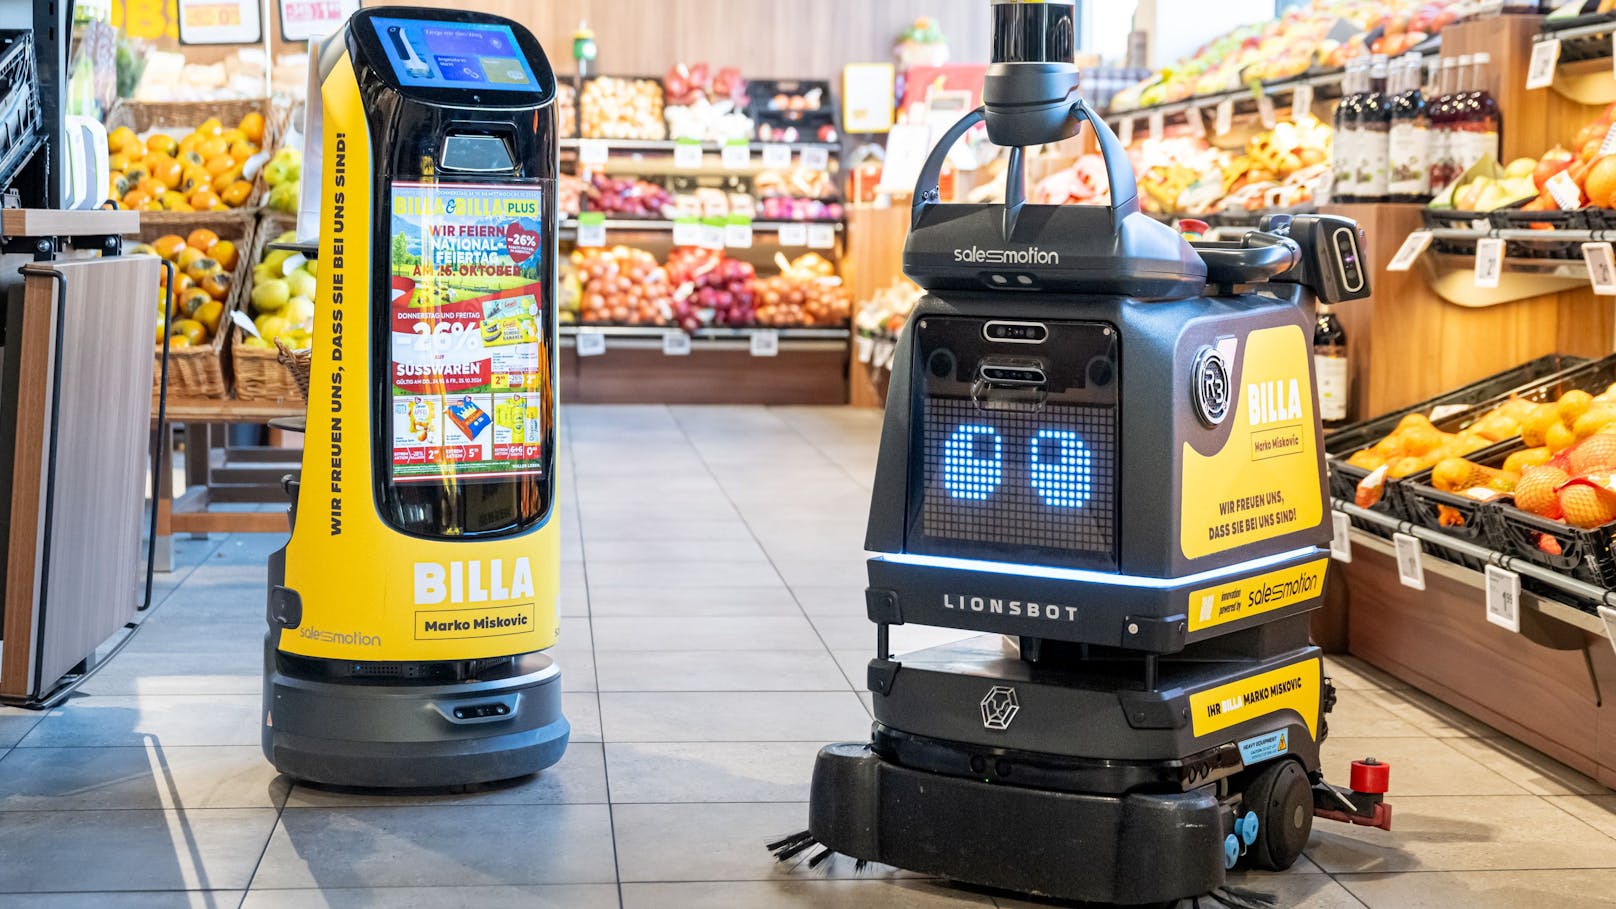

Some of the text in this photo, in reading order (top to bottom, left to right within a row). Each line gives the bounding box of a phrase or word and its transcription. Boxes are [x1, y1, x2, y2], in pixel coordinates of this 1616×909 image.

[508, 203, 535, 213] PLUS
[429, 225, 505, 238] WIR FEIERN
[507, 234, 536, 247] -26%
[431, 238, 506, 251] NATIONAL-
[436, 251, 499, 264] FEIERTAG
[413, 265, 433, 276] AM
[459, 265, 521, 277] OKTOBER
[397, 312, 440, 320] DONNERSTAG
[331, 132, 346, 536] WIR FREUEN UNS, DASS SIE BEI UNS SIND!
[396, 321, 479, 352] -26%
[1247, 378, 1303, 426] BILLA
[1254, 433, 1299, 453] Marko Miskovic
[1219, 490, 1285, 516] WIR FREUEN UNS,
[1208, 508, 1297, 540] DASS SIE BEI UNS SIND!
[414, 556, 535, 605] BILLA
[943, 593, 1078, 622] LIONSBOT
[424, 612, 528, 633] Marko Miskovic
[1207, 677, 1302, 717] IHR BILLA MARKO MISKOVIC
